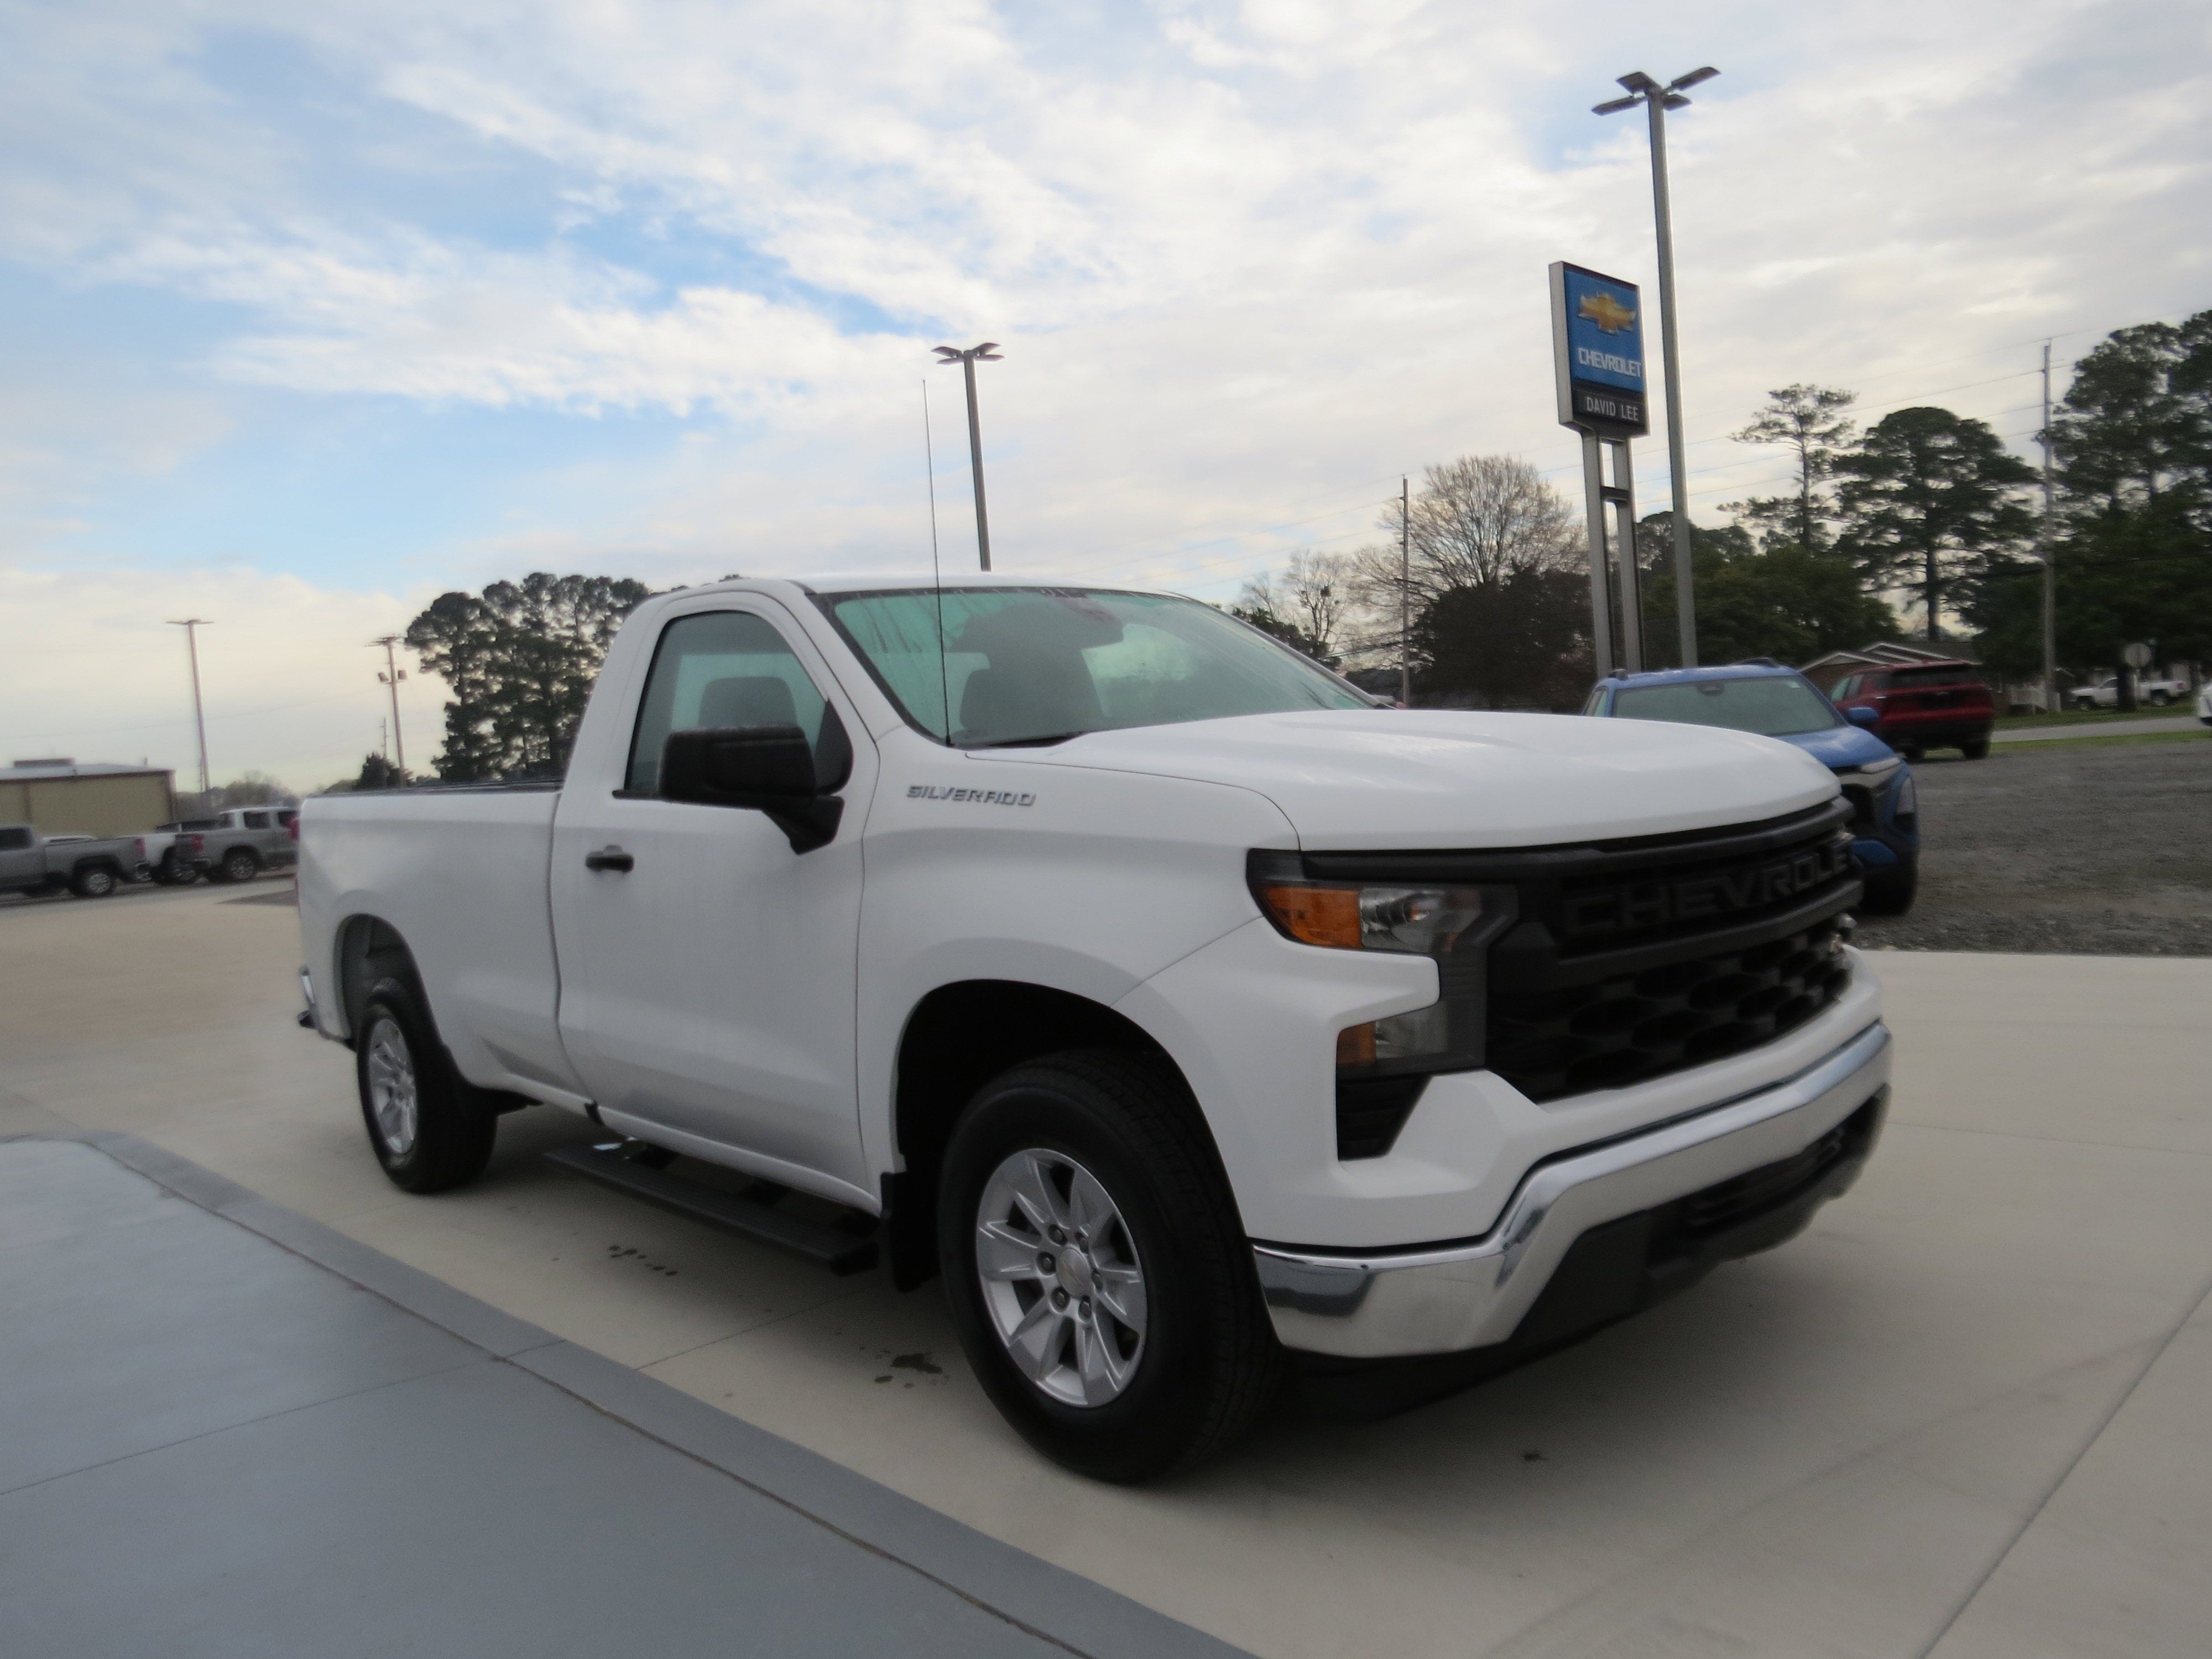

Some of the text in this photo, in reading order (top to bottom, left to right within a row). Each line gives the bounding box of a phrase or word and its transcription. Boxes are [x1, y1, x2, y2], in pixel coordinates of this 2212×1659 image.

[1578, 347, 1642, 377] CHEVROLET
[1586, 397, 1639, 421] DAVID LEE
[907, 785, 1037, 807] SILVERADO
[1563, 844, 1850, 933] CHEVROLE
